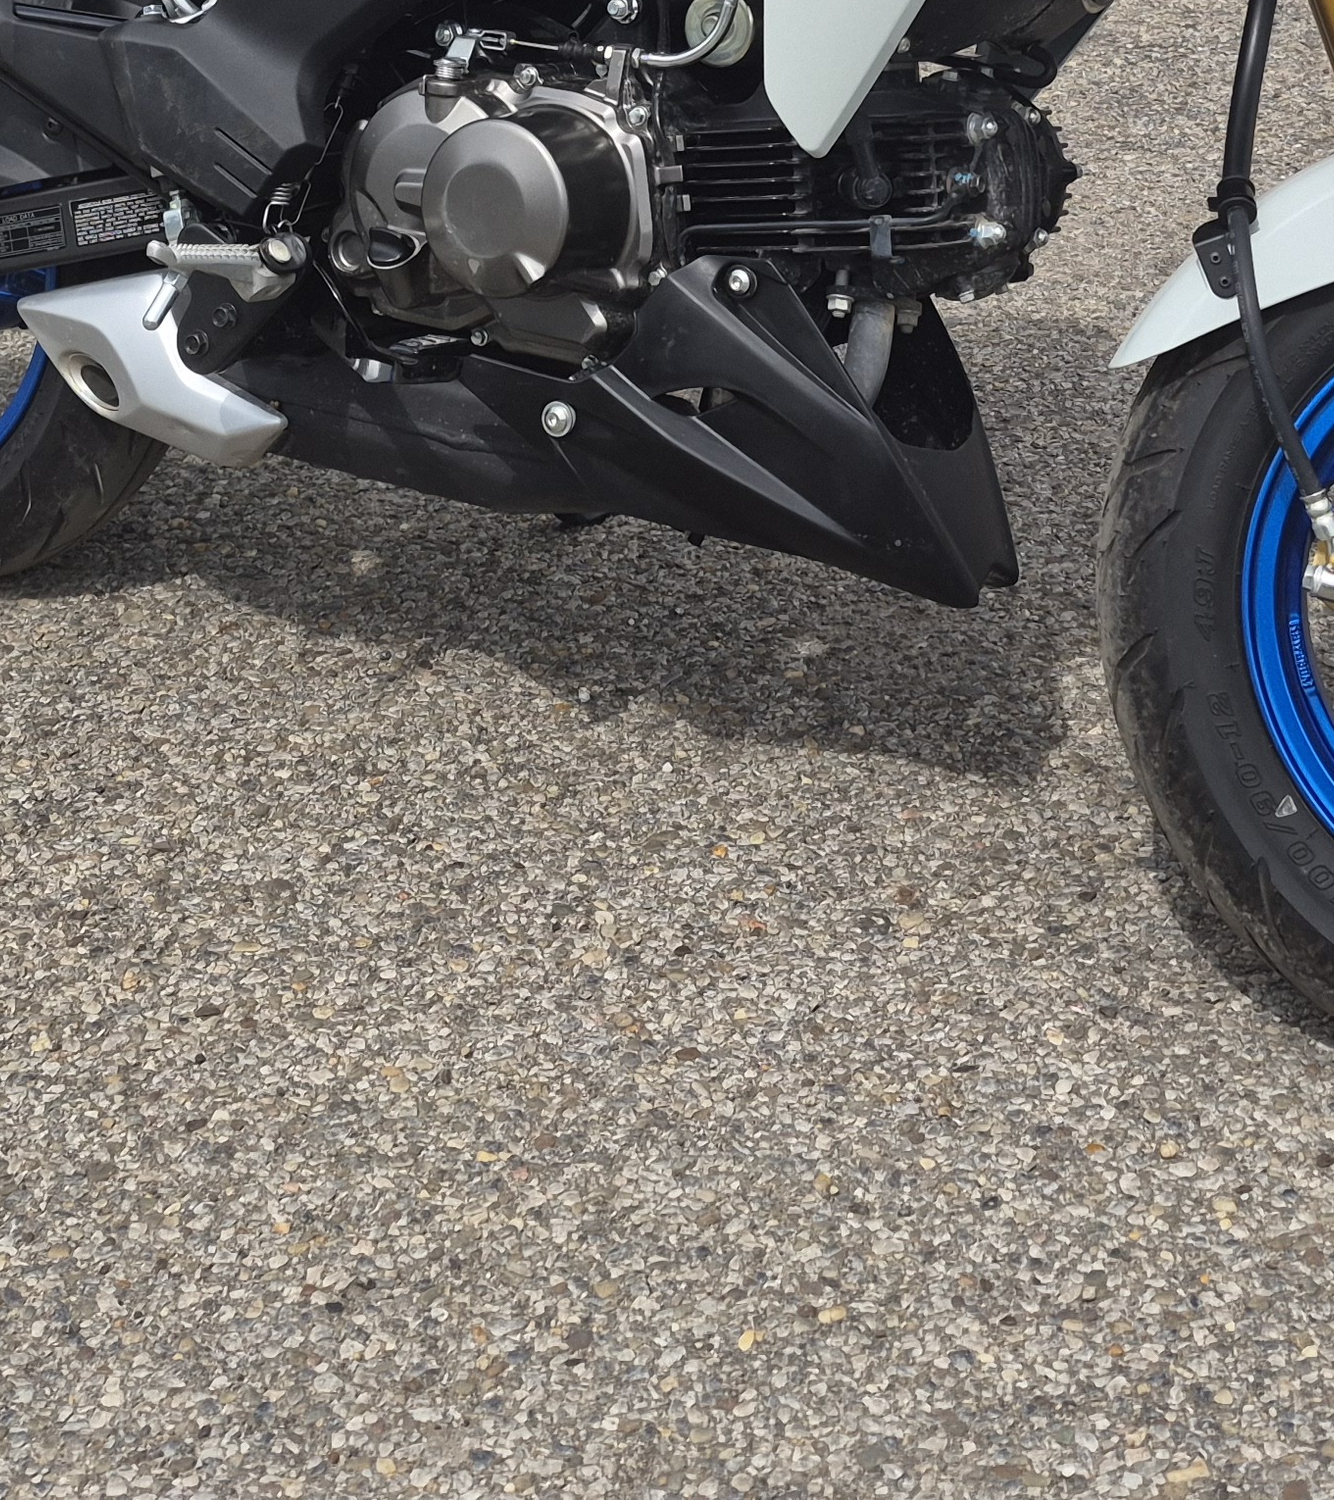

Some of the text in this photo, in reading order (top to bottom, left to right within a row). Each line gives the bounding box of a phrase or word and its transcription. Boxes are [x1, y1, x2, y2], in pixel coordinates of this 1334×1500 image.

[2, 215, 18, 225] LOAD
[19, 212, 36, 222] DATA
[1194, 546, 1221, 641] 49J
